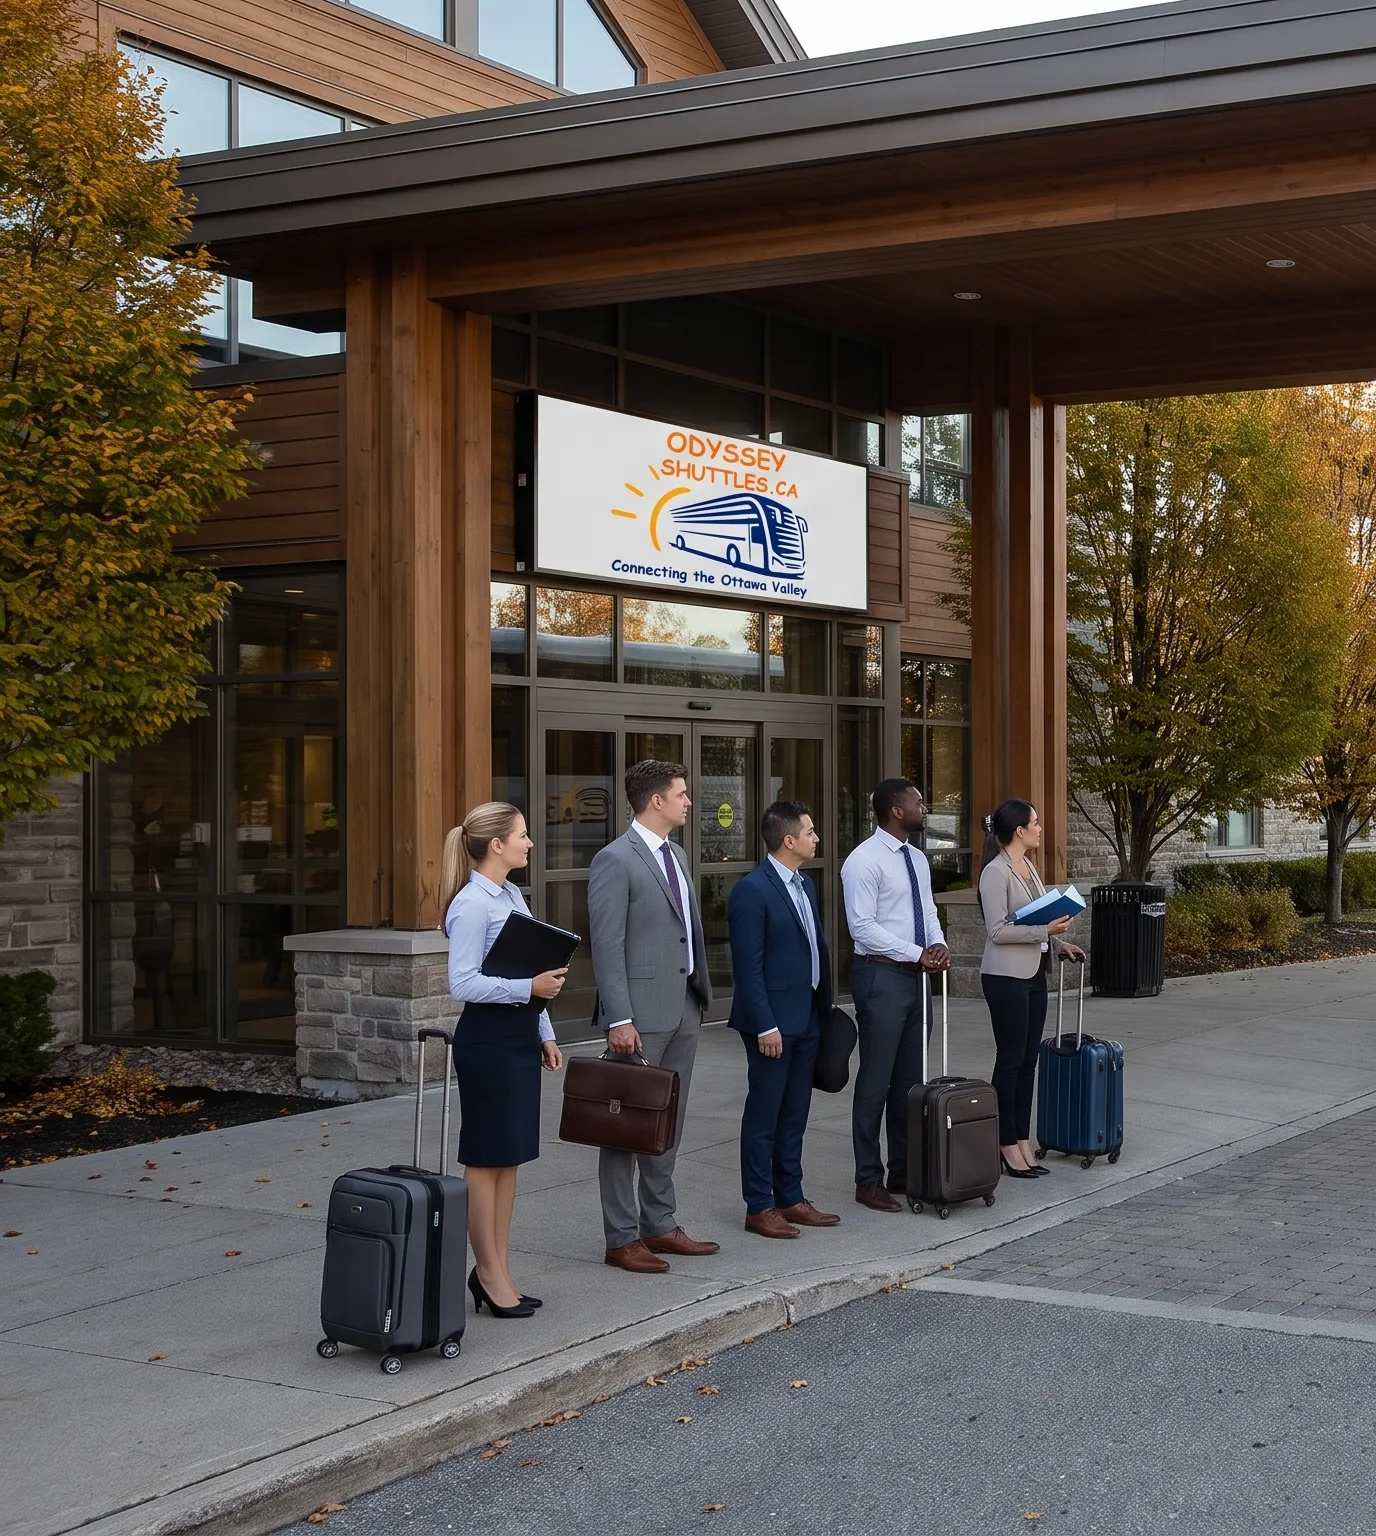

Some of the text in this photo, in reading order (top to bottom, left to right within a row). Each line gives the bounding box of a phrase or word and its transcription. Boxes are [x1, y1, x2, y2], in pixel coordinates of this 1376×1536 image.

[666, 431, 786, 473] ODYSSEY
[660, 458, 798, 499] SHUTTLES.CA
[611, 559, 807, 599] Connecting the Ottawa Valley
